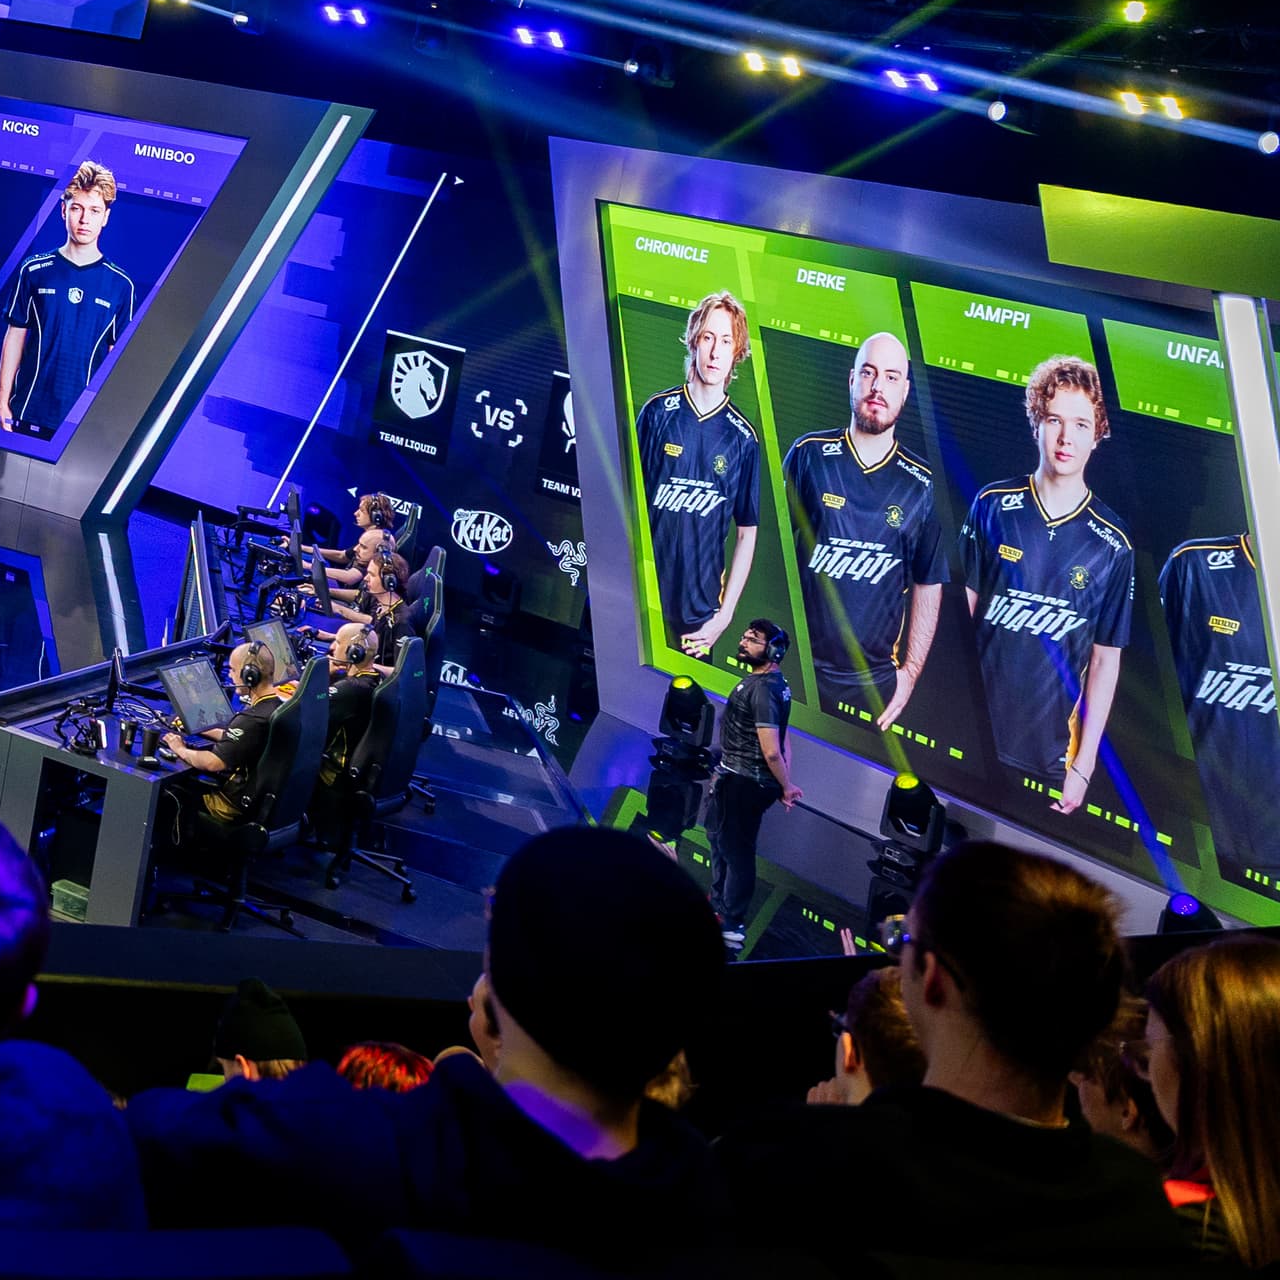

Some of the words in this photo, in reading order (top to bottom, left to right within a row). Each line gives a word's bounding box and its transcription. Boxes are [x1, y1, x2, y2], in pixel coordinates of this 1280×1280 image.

[2, 120, 40, 137] KICKS
[134, 143, 196, 165] MINIBOO
[635, 237, 709, 263] CHRONICLE
[797, 269, 847, 292] DERKE
[964, 302, 1030, 329] JAMPPI
[485, 405, 515, 431] VS
[380, 431, 404, 446] TEAM
[405, 438, 437, 456] LIQUID
[542, 478, 571, 494] TEAM
[458, 513, 510, 551] KitKat
[828, 537, 887, 551] TEAM
[1007, 589, 1070, 607] TEAM
